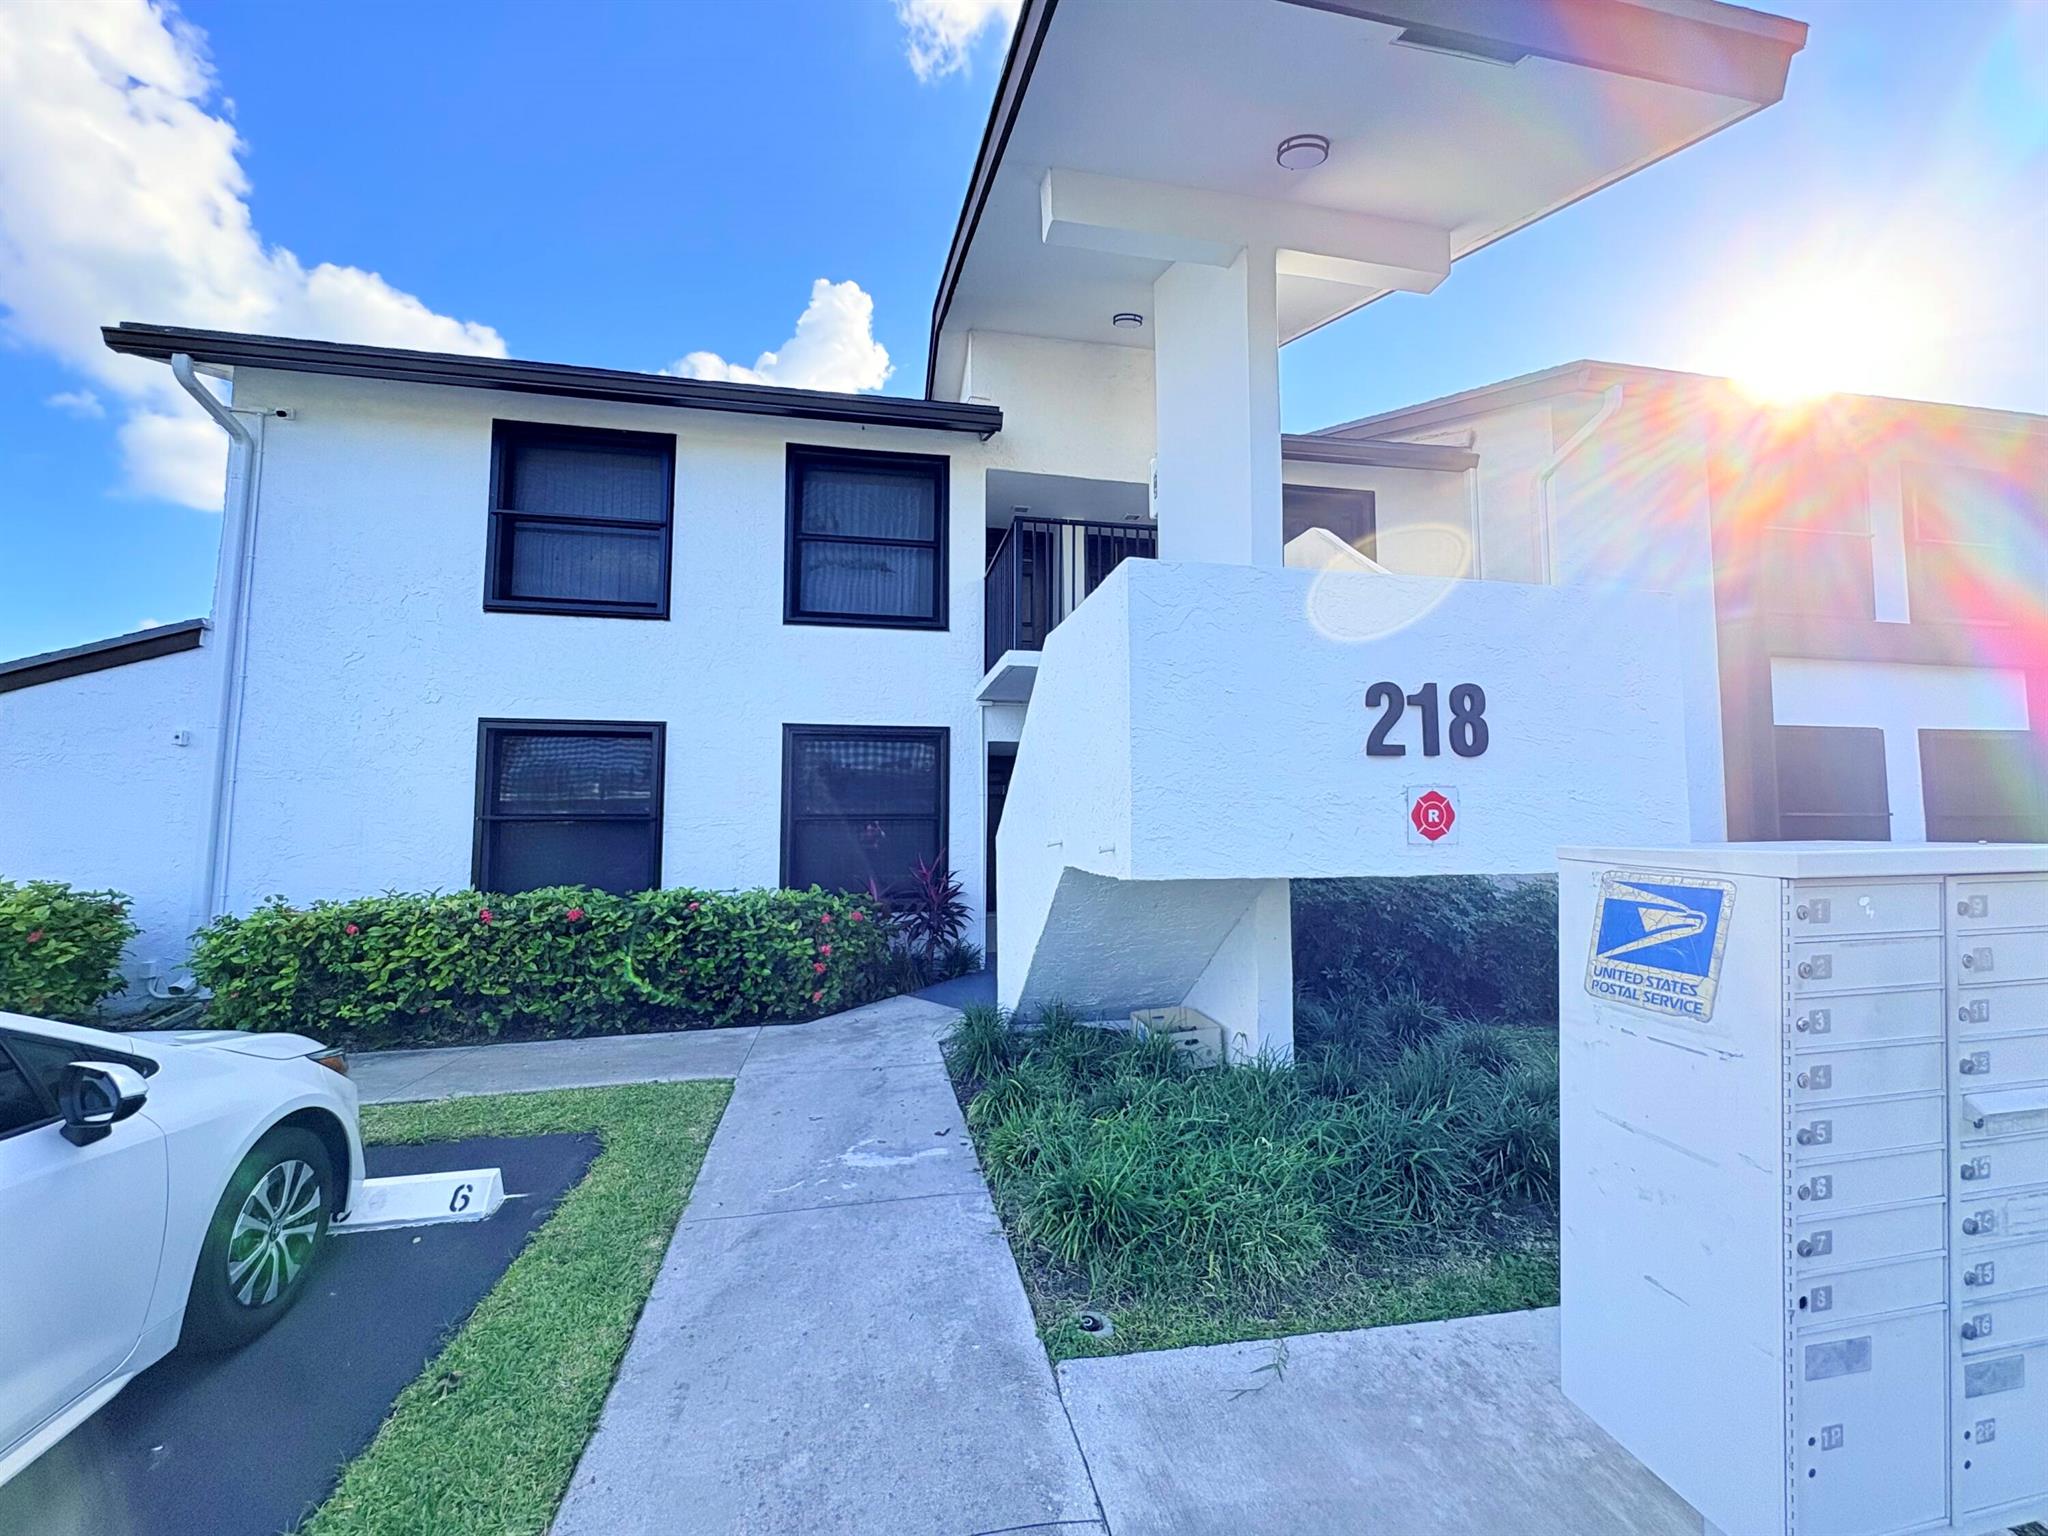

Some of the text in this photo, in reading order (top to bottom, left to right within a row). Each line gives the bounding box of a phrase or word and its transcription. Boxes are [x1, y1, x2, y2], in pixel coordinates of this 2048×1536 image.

[1365, 681, 1489, 758] 218
[1427, 809, 1440, 823] R
[1815, 958, 1826, 976] 2
[1593, 964, 1698, 997] UNITED STATES
[1591, 979, 1704, 1015] POSTAL SERVICE
[1815, 1011, 1825, 1031] 3
[1816, 1123, 1826, 1141] 5
[450, 1184, 473, 1212] 6
[1816, 1234, 1826, 1252] 7
[1822, 1428, 1841, 1447] 1P
